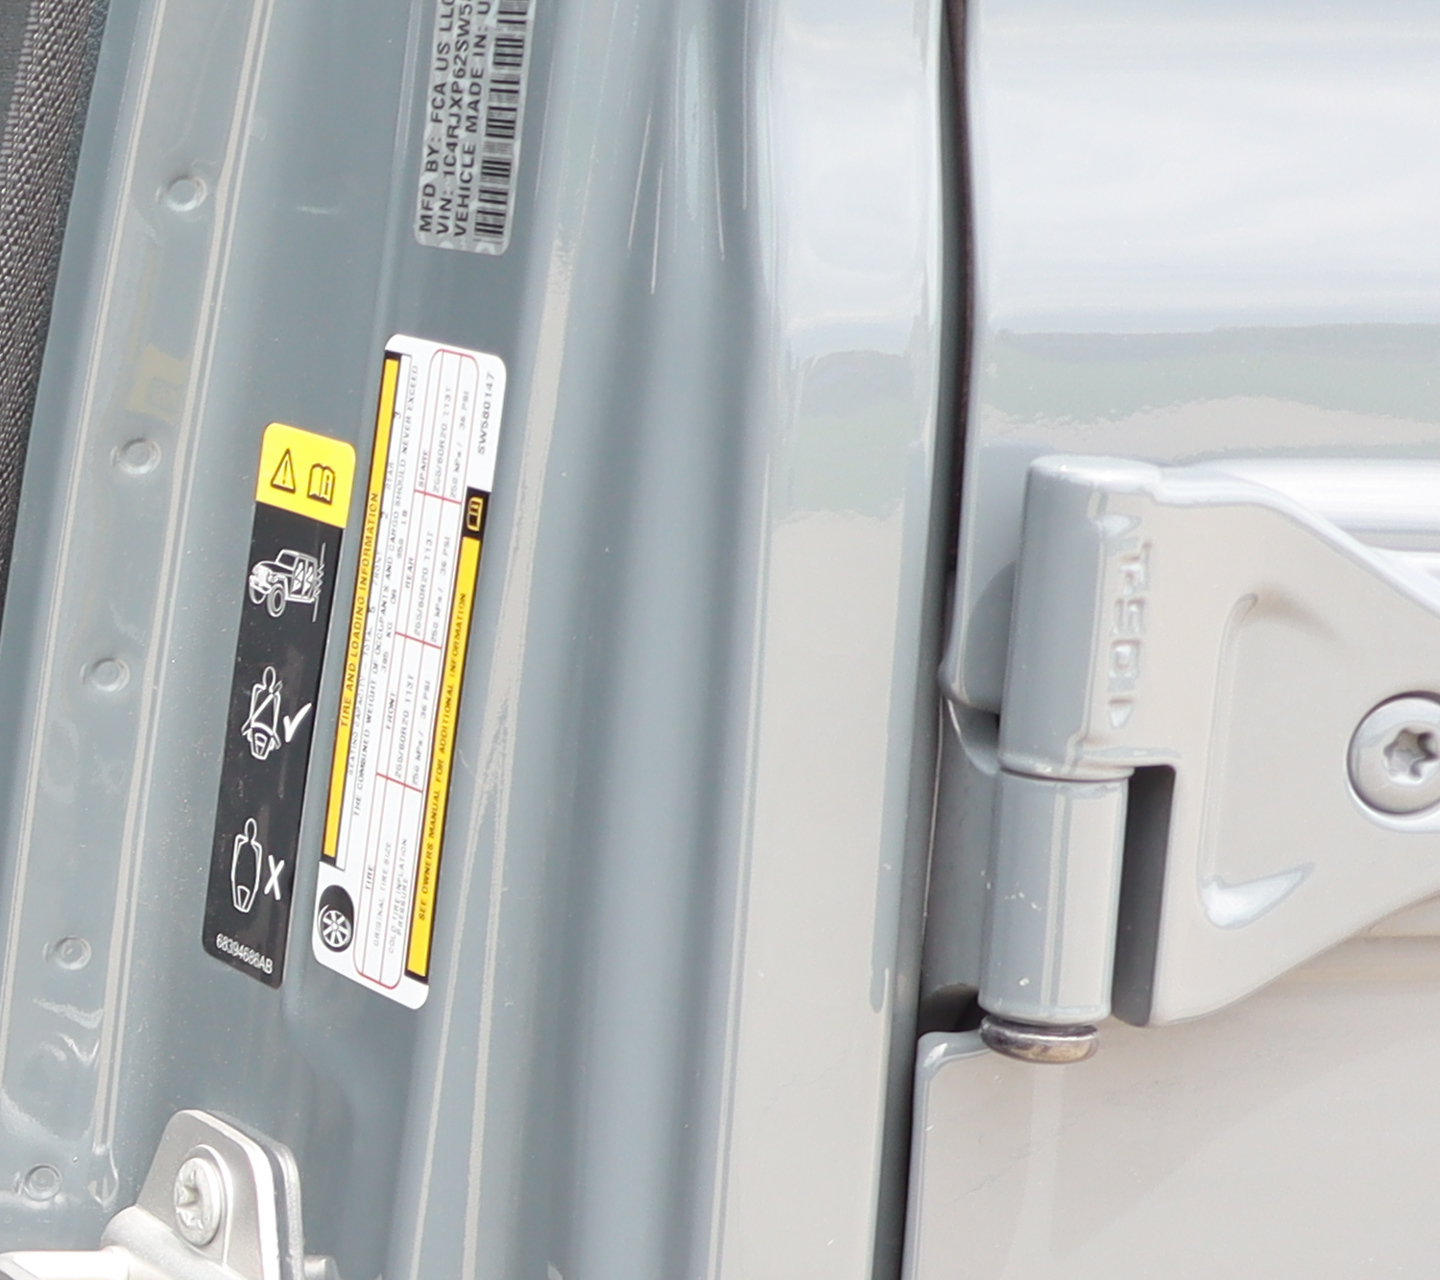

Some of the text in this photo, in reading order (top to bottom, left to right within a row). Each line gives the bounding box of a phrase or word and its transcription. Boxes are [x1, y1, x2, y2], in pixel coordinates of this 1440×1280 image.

[435, 41, 451, 71] US
[472, 28, 487, 57] IN:
[430, 82, 446, 123] FCA
[465, 69, 484, 133] MADE
[425, 138, 441, 172] BY:
[419, 183, 436, 232] MFD
[454, 145, 476, 236] VEHICLE
[436, 191, 453, 234] VIN:
[407, 365, 417, 411] EXCEED
[401, 415, 411, 454] NEVER
[477, 373, 493, 454] SW580147
[395, 458, 406, 507] SHOULD
[418, 450, 429, 487] SPARE
[389, 511, 399, 551] CARGO
[405, 557, 415, 589] REAR
[340, 493, 378, 727] TIRE AND LOADING INFORMATION
[375, 585, 389, 655] OCCUPANTS
[372, 661, 379, 674] OF
[365, 680, 376, 724] WEIGHT
[385, 692, 396, 730] FRONT
[357, 729, 369, 790] COMBINED
[418, 593, 466, 921] SEE OWNERS MANUAL FOR ADDITIONAL INFORMATION
[353, 796, 361, 816] THE
[365, 866, 376, 892] TIRE
